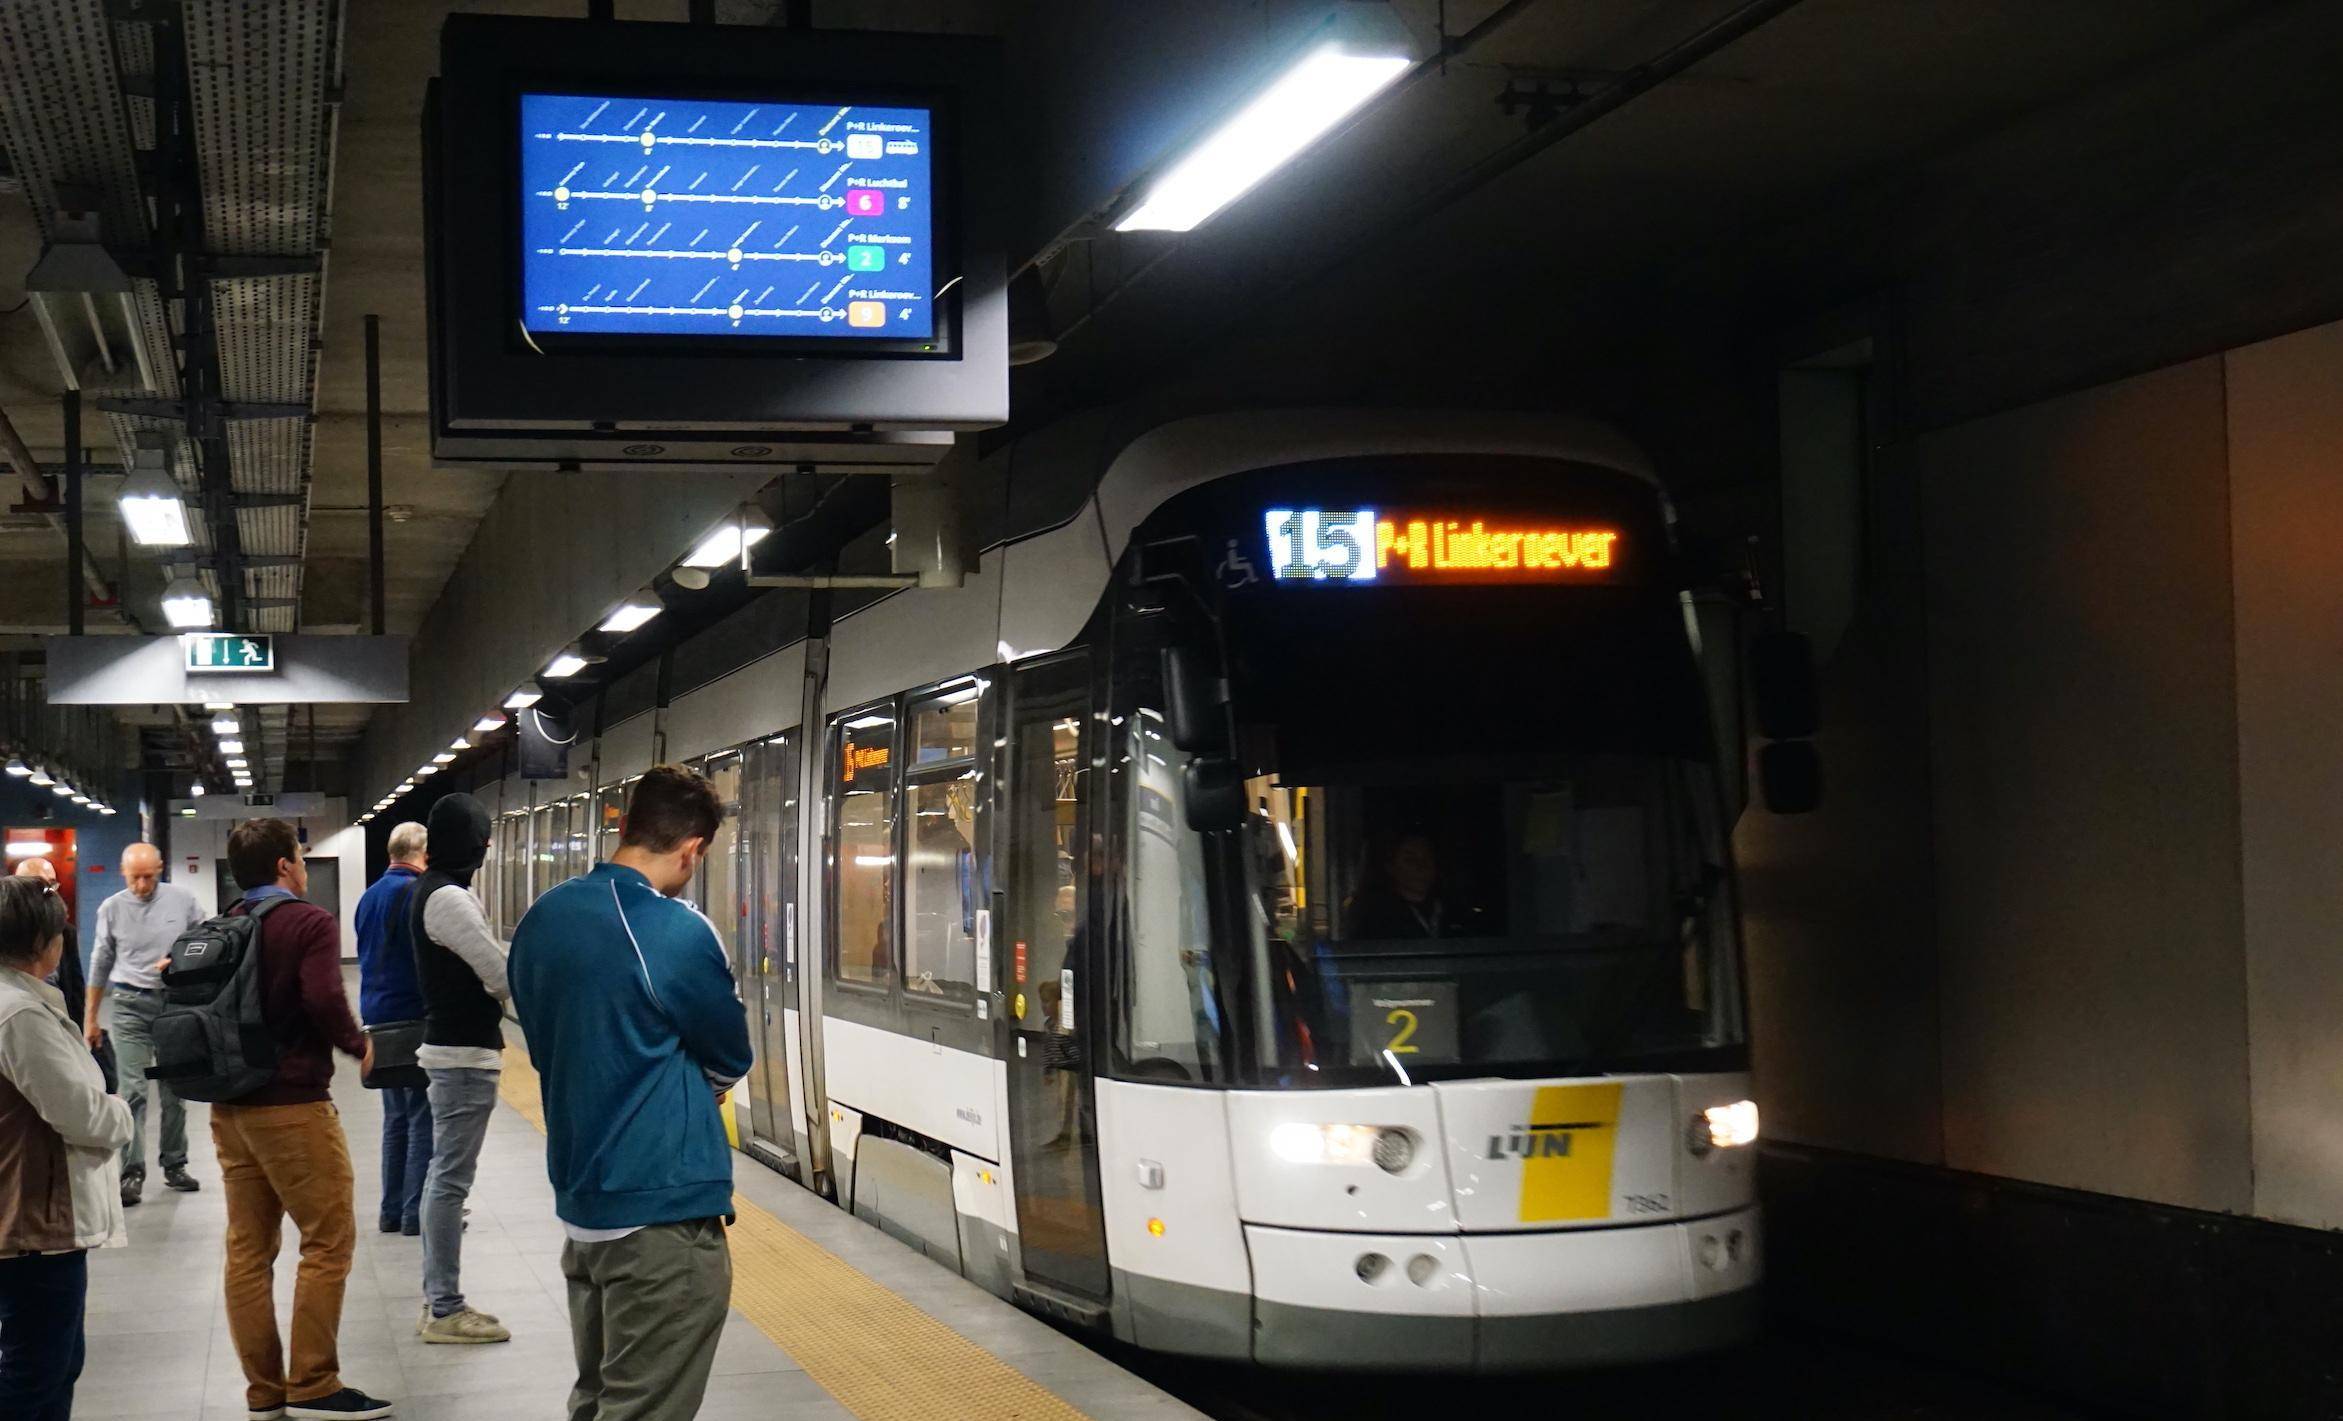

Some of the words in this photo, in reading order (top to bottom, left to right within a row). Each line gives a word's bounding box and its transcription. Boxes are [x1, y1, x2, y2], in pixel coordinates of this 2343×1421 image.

[859, 194, 873, 211] 6
[860, 251, 872, 267] 2
[1279, 511, 1363, 578] 15
[1386, 1009, 1420, 1054] 2
